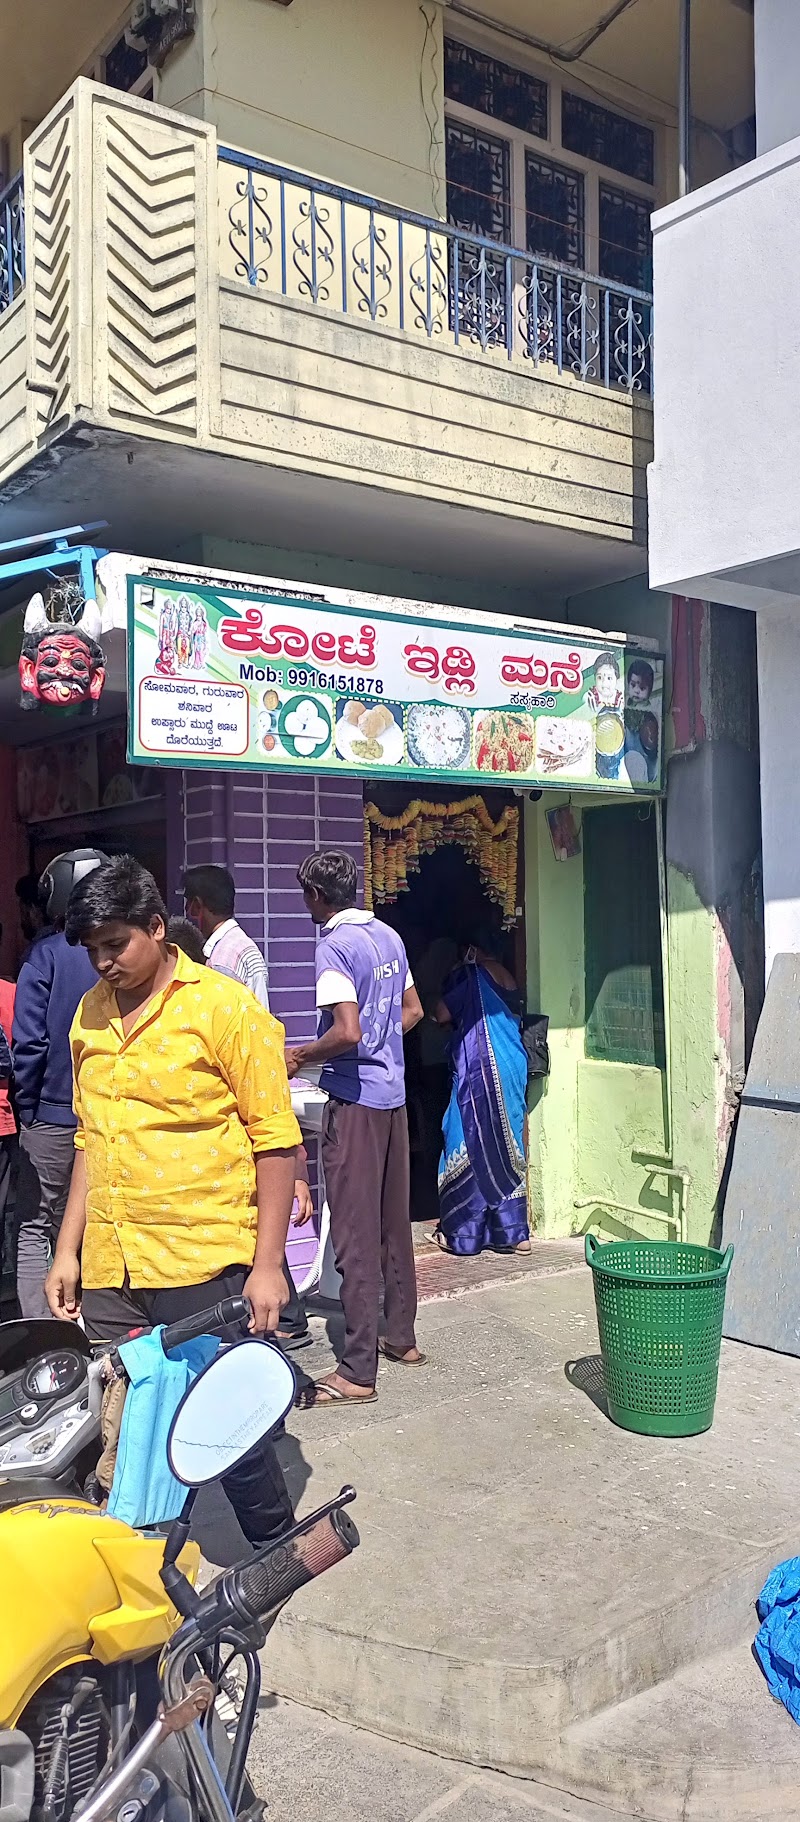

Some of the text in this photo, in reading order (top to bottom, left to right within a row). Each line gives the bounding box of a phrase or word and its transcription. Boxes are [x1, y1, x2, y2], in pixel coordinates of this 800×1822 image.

[220, 608, 582, 693] ಕೋಟೆ ಇಡ್ಲಿ ಮನೆ
[238, 663, 384, 694] Mob: 9916151878
[144, 680, 245, 699] ಸೋಮವಾರ, ಗುರುವಾರ
[177, 700, 213, 713] ಶನಿವಾರ
[190, 719, 214, 735] ಮುದ್ದೆ
[217, 722, 238, 732] ಊಟ
